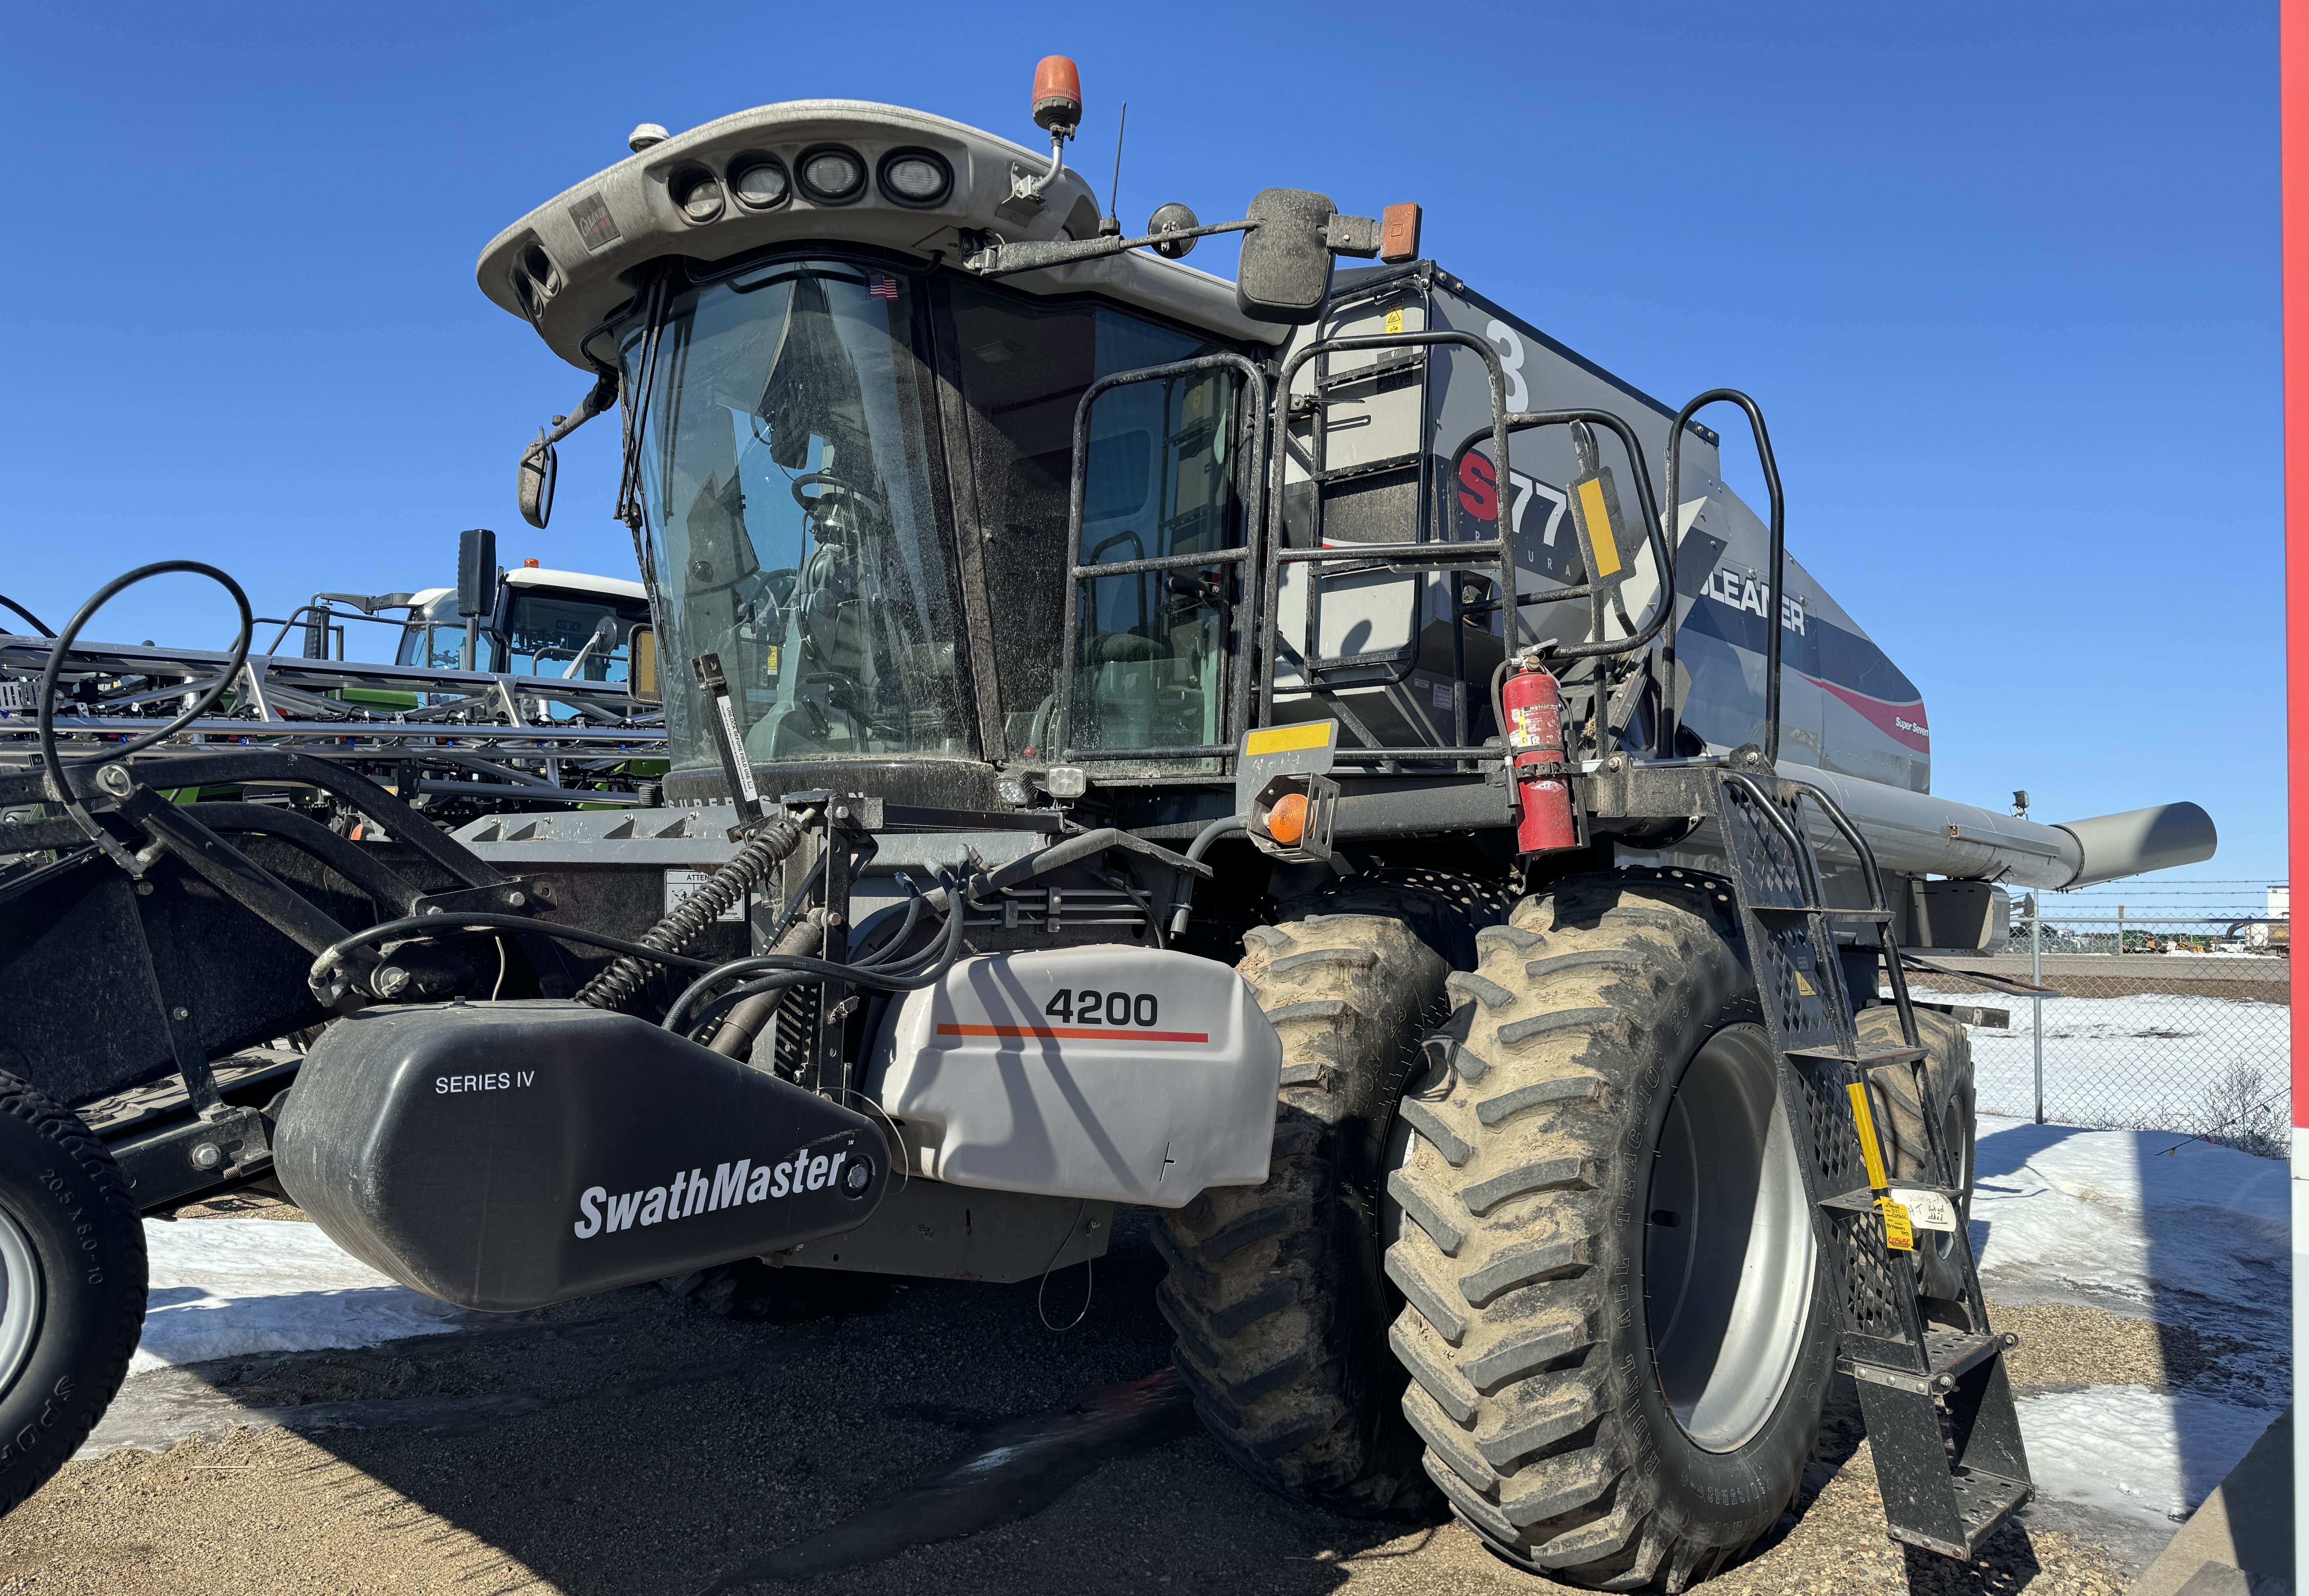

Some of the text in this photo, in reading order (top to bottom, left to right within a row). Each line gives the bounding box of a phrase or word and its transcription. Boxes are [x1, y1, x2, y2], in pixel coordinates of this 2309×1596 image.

[1486, 319, 1528, 412] 3
[726, 707, 736, 730] UNLOCK
[733, 731, 743, 752] BEFORE
[1895, 717, 1929, 737] Super Seven
[1045, 989, 1158, 1027] 4200
[436, 1071, 535, 1094] SERIES IV
[1615, 1042, 1666, 1227] TRACTION
[39, 1168, 74, 1204] 20.5
[574, 1149, 846, 1239] SwathMaster
[1614, 1258, 1631, 1329] ALL
[1621, 1354, 1660, 1476] RADIAL
